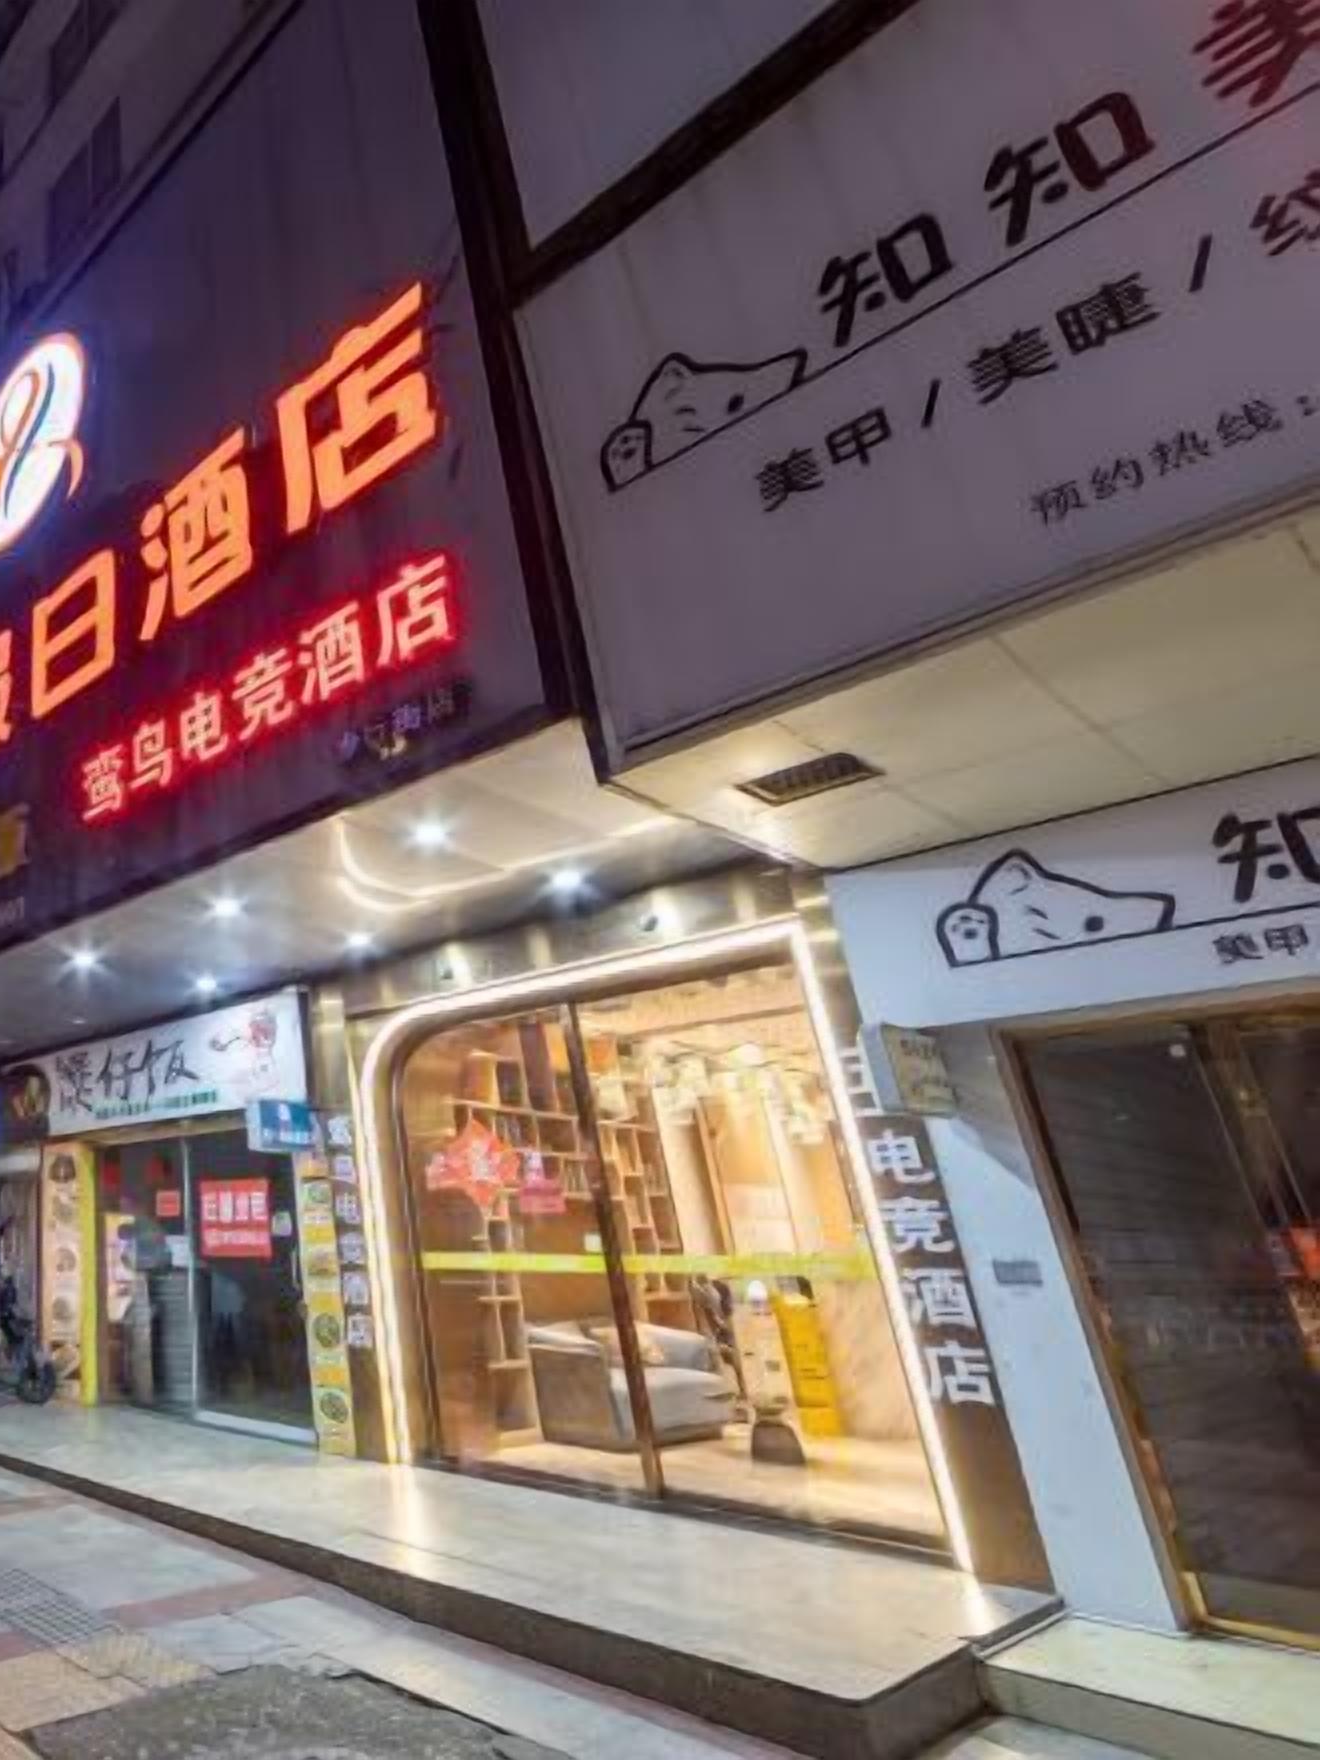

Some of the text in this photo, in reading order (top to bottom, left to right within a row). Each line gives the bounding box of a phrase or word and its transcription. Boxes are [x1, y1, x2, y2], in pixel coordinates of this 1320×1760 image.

[81, 554, 453, 821] 鸾鸟电竞酒店
